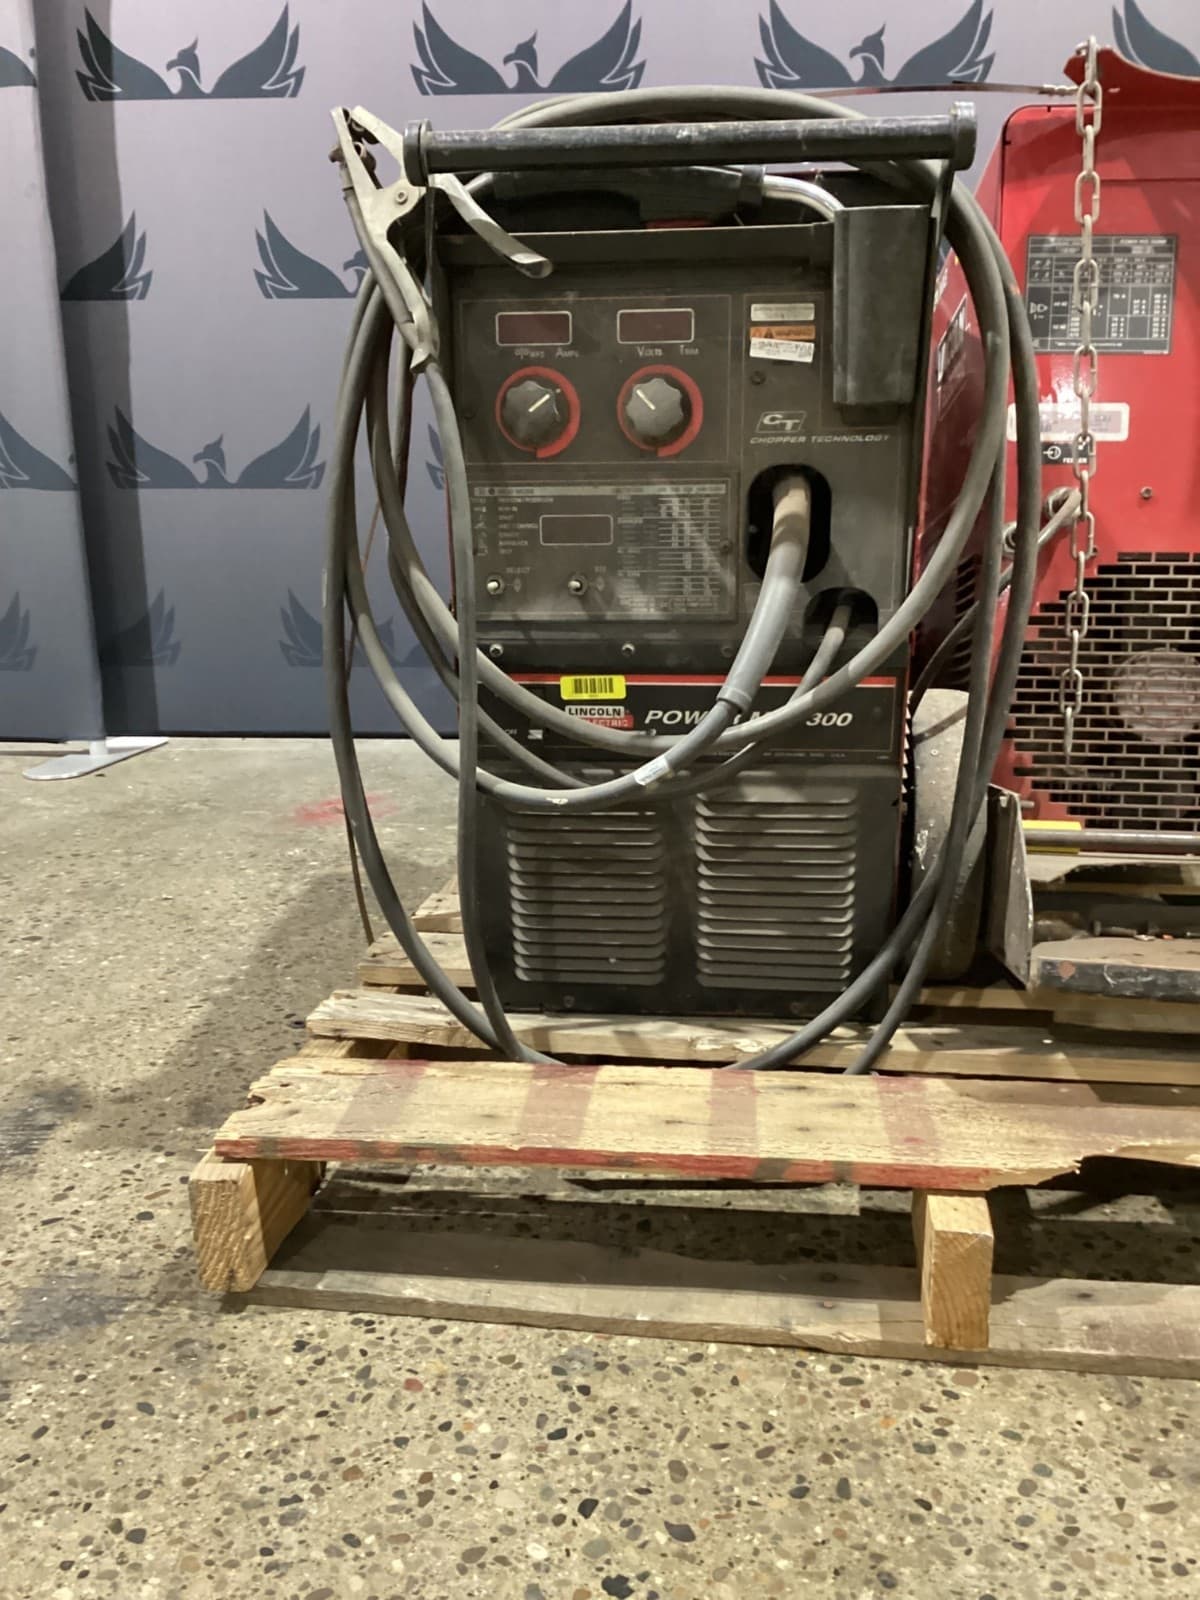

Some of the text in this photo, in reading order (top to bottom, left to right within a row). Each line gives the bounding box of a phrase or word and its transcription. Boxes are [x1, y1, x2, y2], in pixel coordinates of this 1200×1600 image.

[749, 434, 889, 444] CHOPPER TECHNOLOGY
[568, 706, 622, 717] LINCOLN
[805, 712, 853, 727] 300
